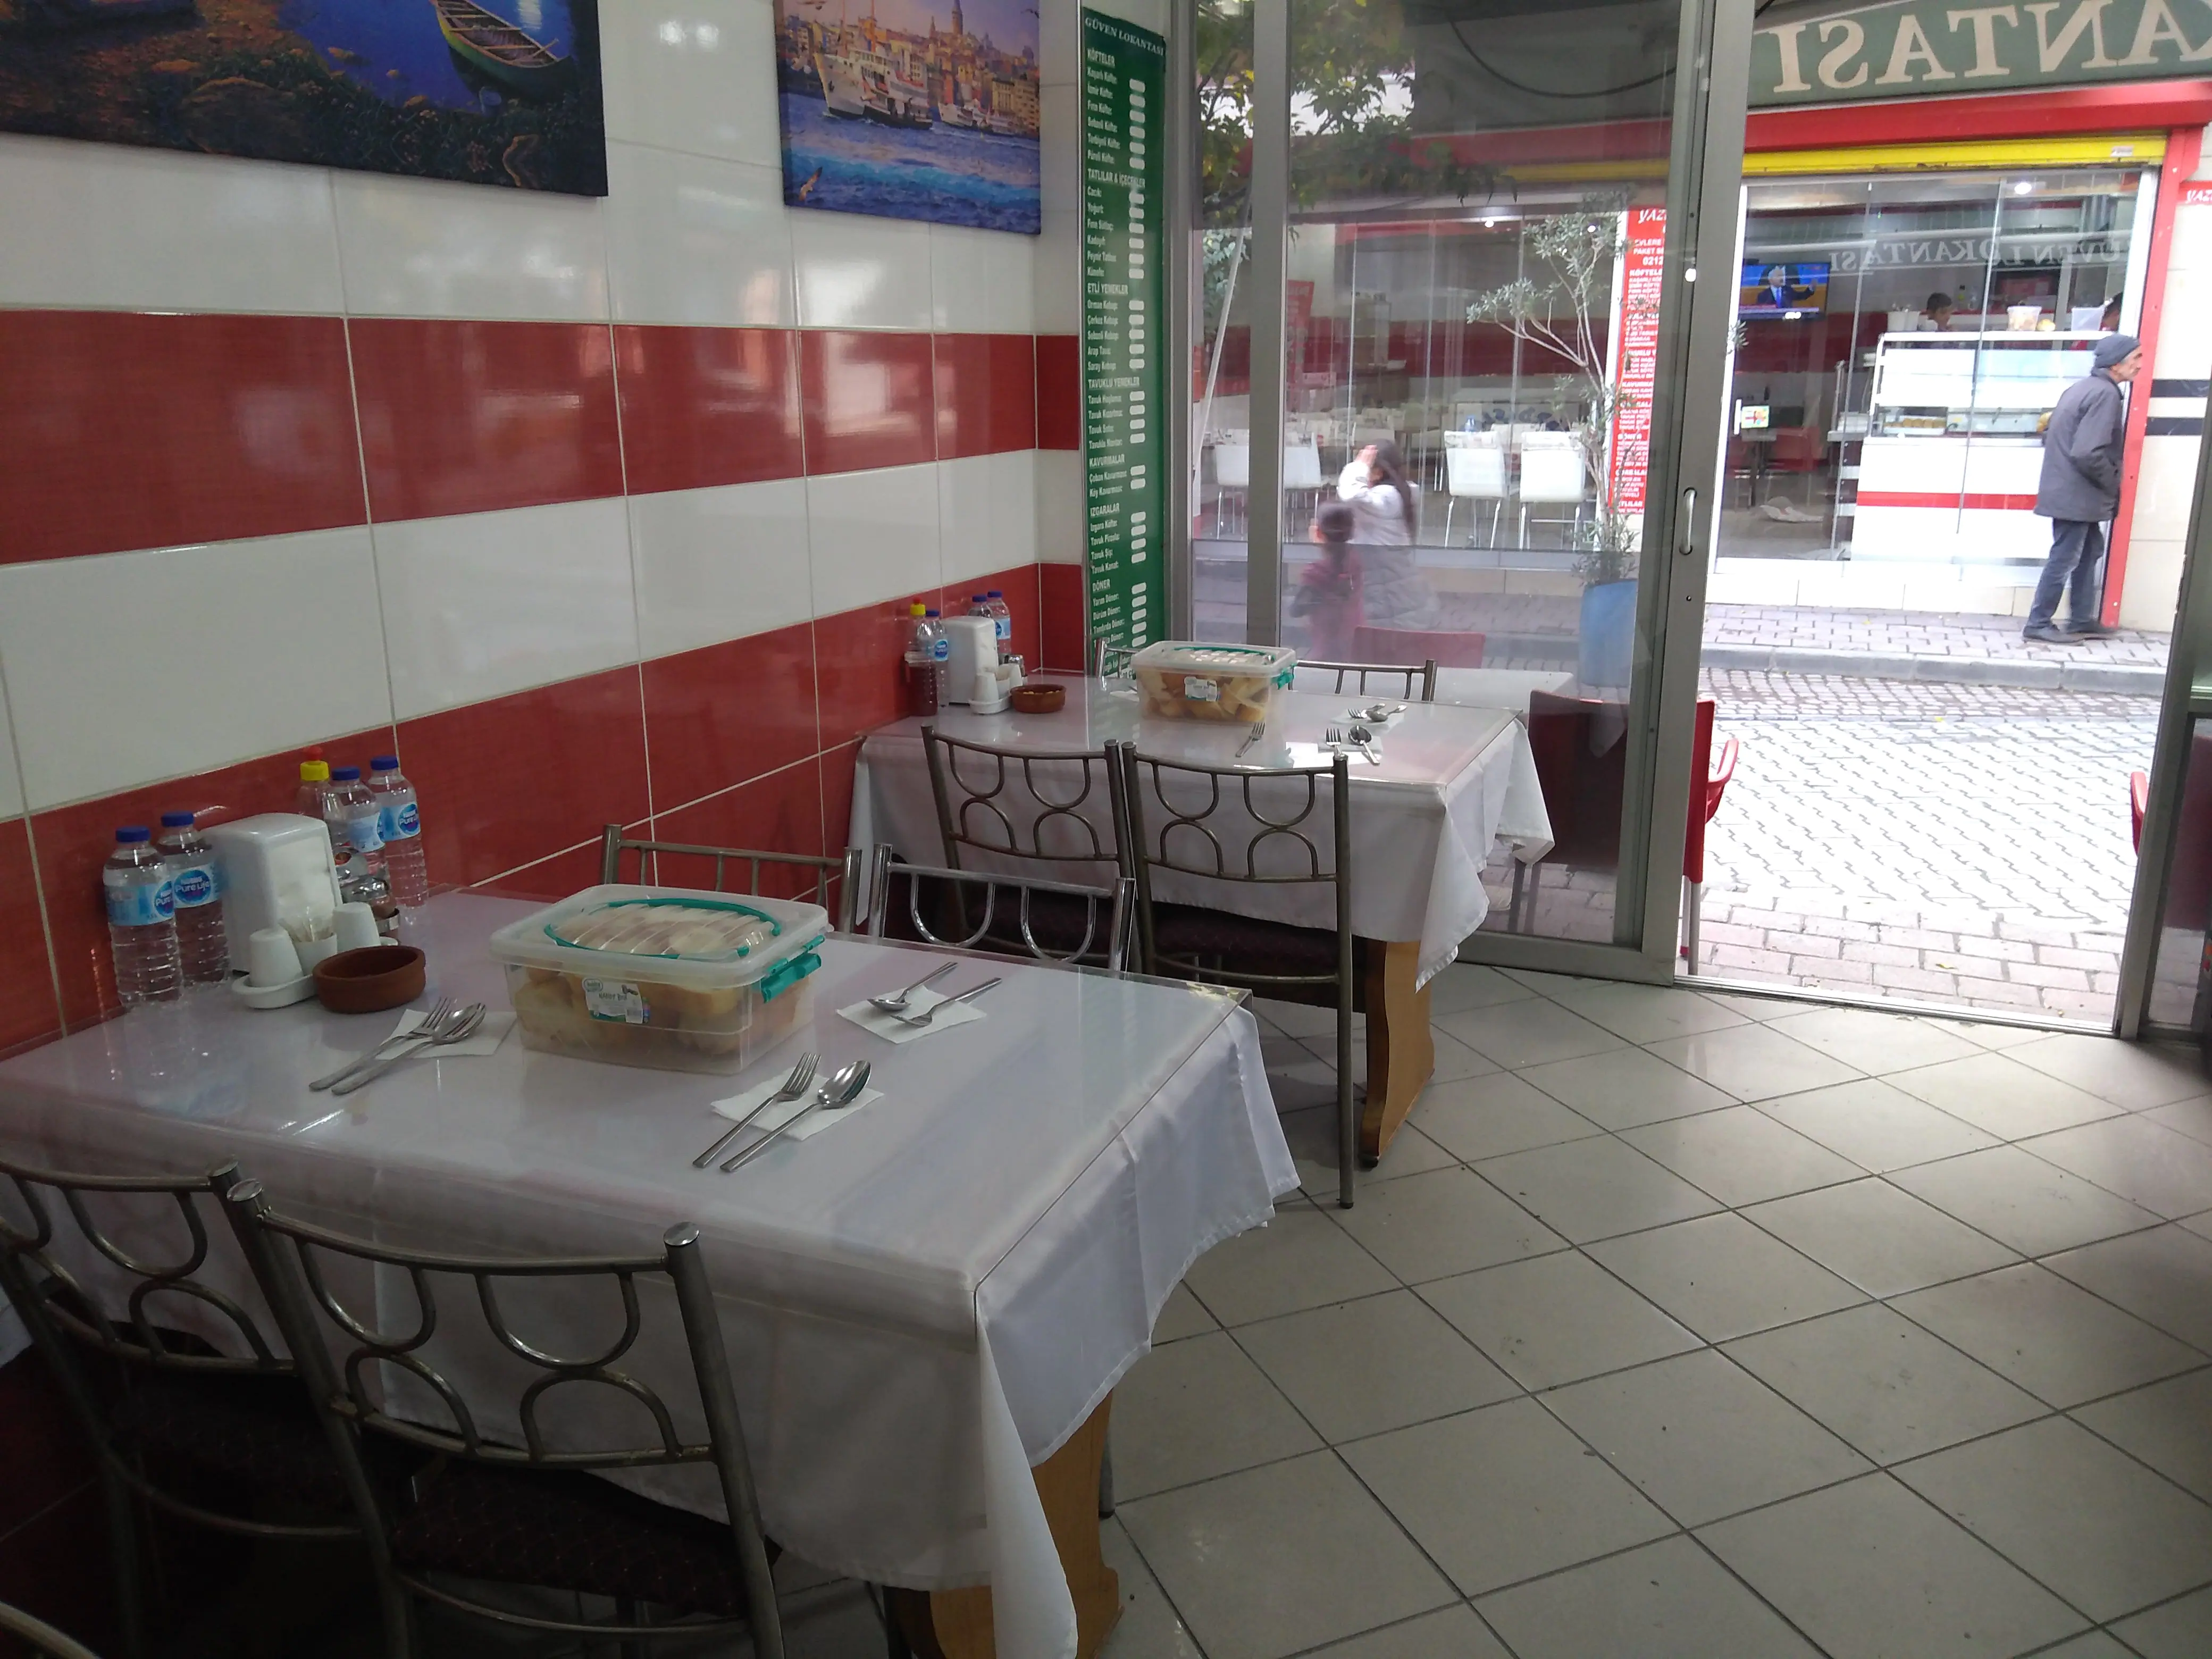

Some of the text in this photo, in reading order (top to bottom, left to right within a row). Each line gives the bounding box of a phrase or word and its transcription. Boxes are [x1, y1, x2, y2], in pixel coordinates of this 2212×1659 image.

[1085, 17, 1163, 56] GÜVEN LOKANTASI
[1087, 47, 1115, 68] KÖFTELER
[1087, 168, 1113, 183] TATLILAR
[1643, 256, 1663, 265] 0212
[1087, 281, 1128, 295] ETLİ YEMEKLER
[1088, 376, 1140, 389] TAVUKLU YEMEKLER
[1088, 395, 1102, 404] Tavuk
[1088, 410, 1102, 419] Tavuk
[1088, 425, 1102, 434] Tavuk
[1089, 454, 1125, 467] KAVURMALAR
[1090, 502, 1120, 518] IZGARALAR
[1091, 535, 1103, 546] Tavuk
[1091, 551, 1104, 560] Tavuk
[1092, 565, 1104, 574] Tavuk
[1093, 579, 1110, 592] DÖNER
[175, 880, 210, 893] Pure Life
